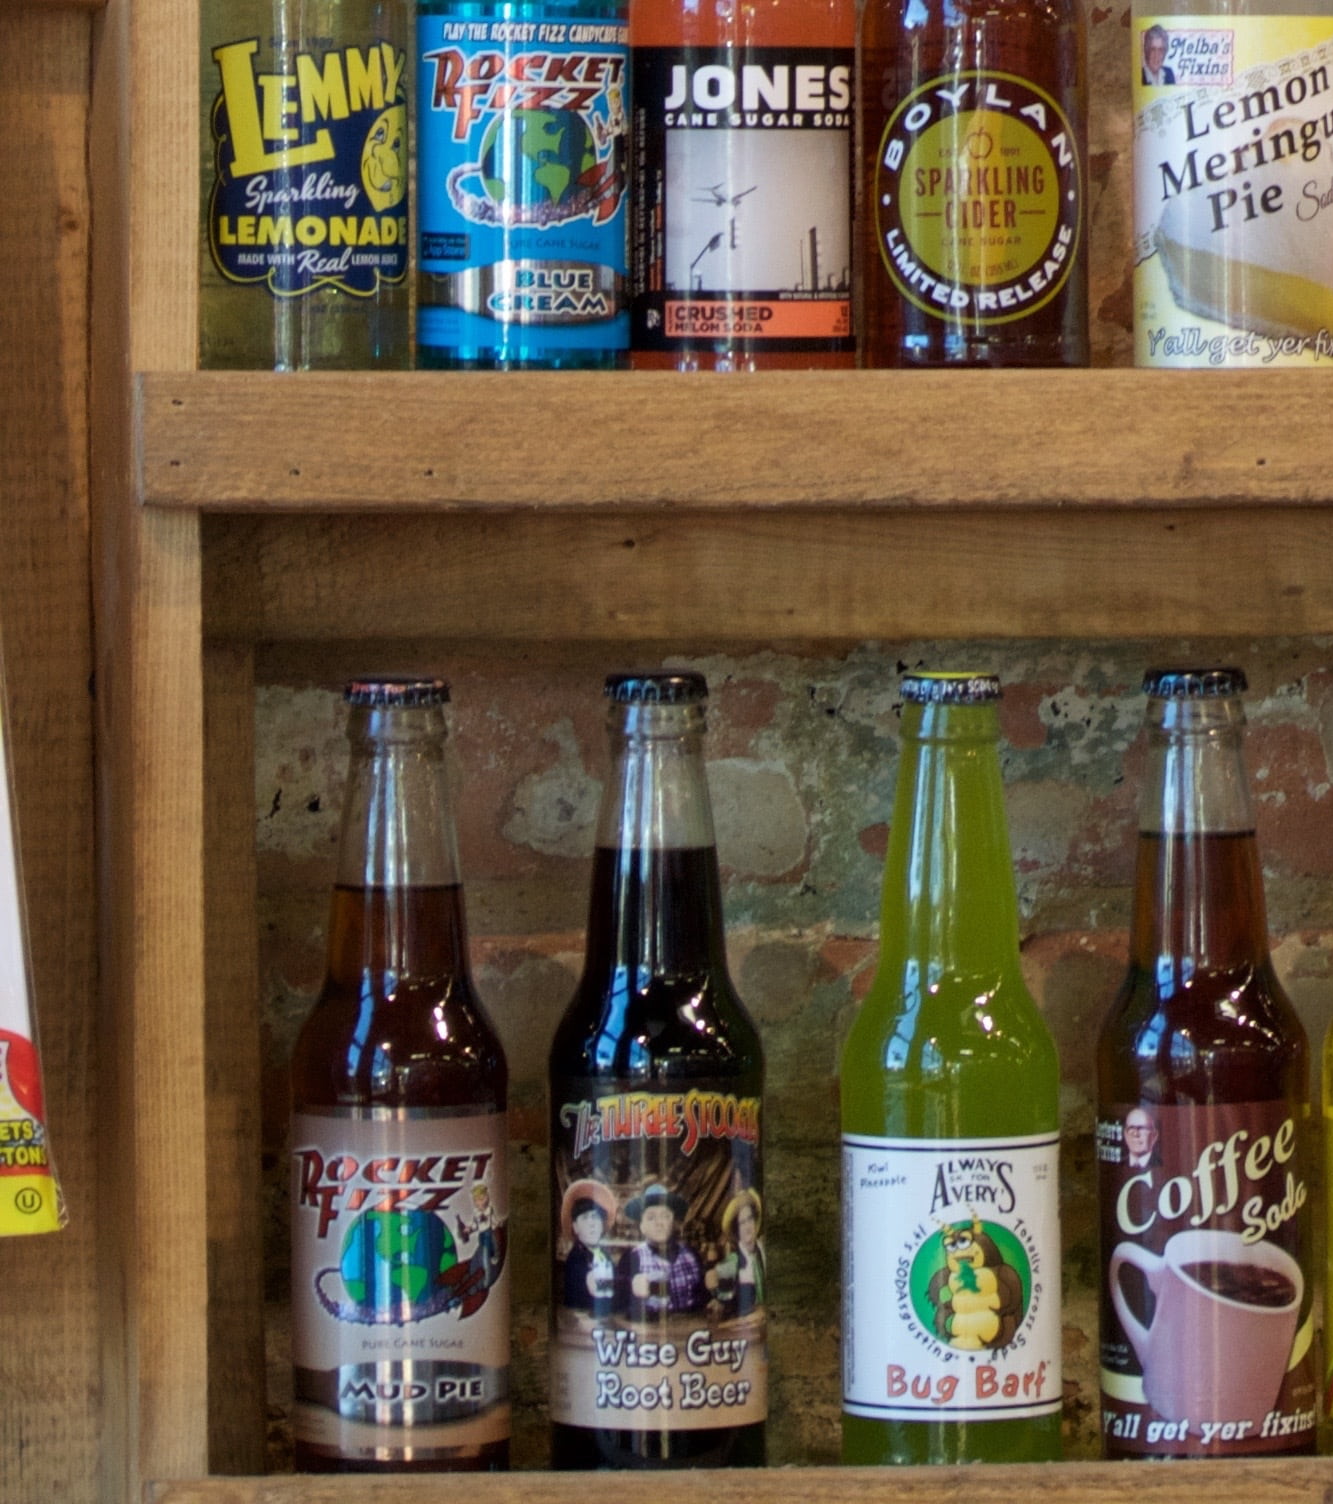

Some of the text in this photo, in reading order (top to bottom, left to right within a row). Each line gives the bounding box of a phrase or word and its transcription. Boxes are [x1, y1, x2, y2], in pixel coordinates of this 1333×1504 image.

[666, 65, 850, 110] JONES
[1180, 65, 1331, 141] Lemon
[666, 113, 803, 127] CANE SUGAR
[885, 88, 1075, 170] BOYLAN
[944, 200, 1016, 229] CIDER
[1209, 184, 1283, 232] Pie
[884, 226, 1075, 310] LIMITED RELEASE
[674, 304, 774, 323] CRUSHED
[1116, 1117, 1295, 1233] Coffee
[342, 1378, 483, 1402] MUD PIE
[885, 1364, 1047, 1403] Bug Barf
